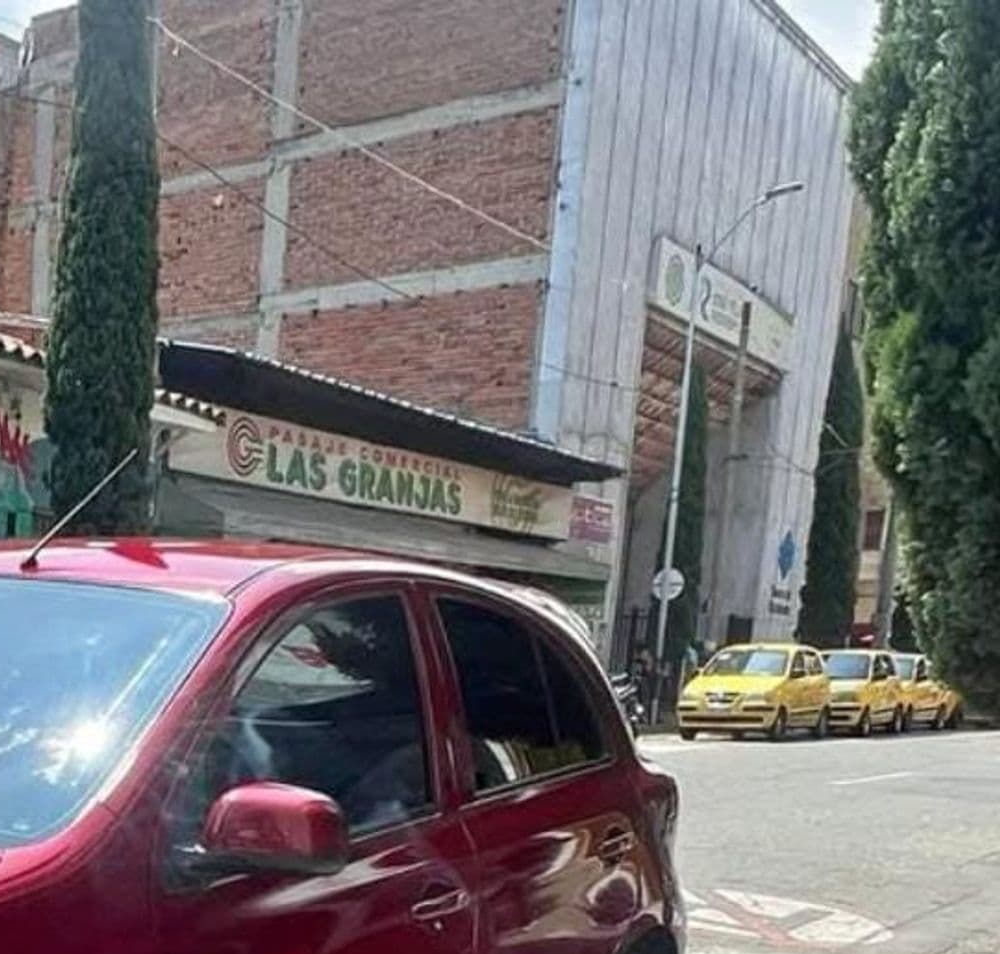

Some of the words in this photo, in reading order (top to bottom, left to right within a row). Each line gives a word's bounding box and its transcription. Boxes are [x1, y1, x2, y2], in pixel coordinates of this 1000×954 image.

[266, 443, 327, 491] LAS
[338, 458, 462, 515] GRANJAS
[269, 426, 347, 456] PASAJE
[359, 446, 462, 480] COMERCIAL
